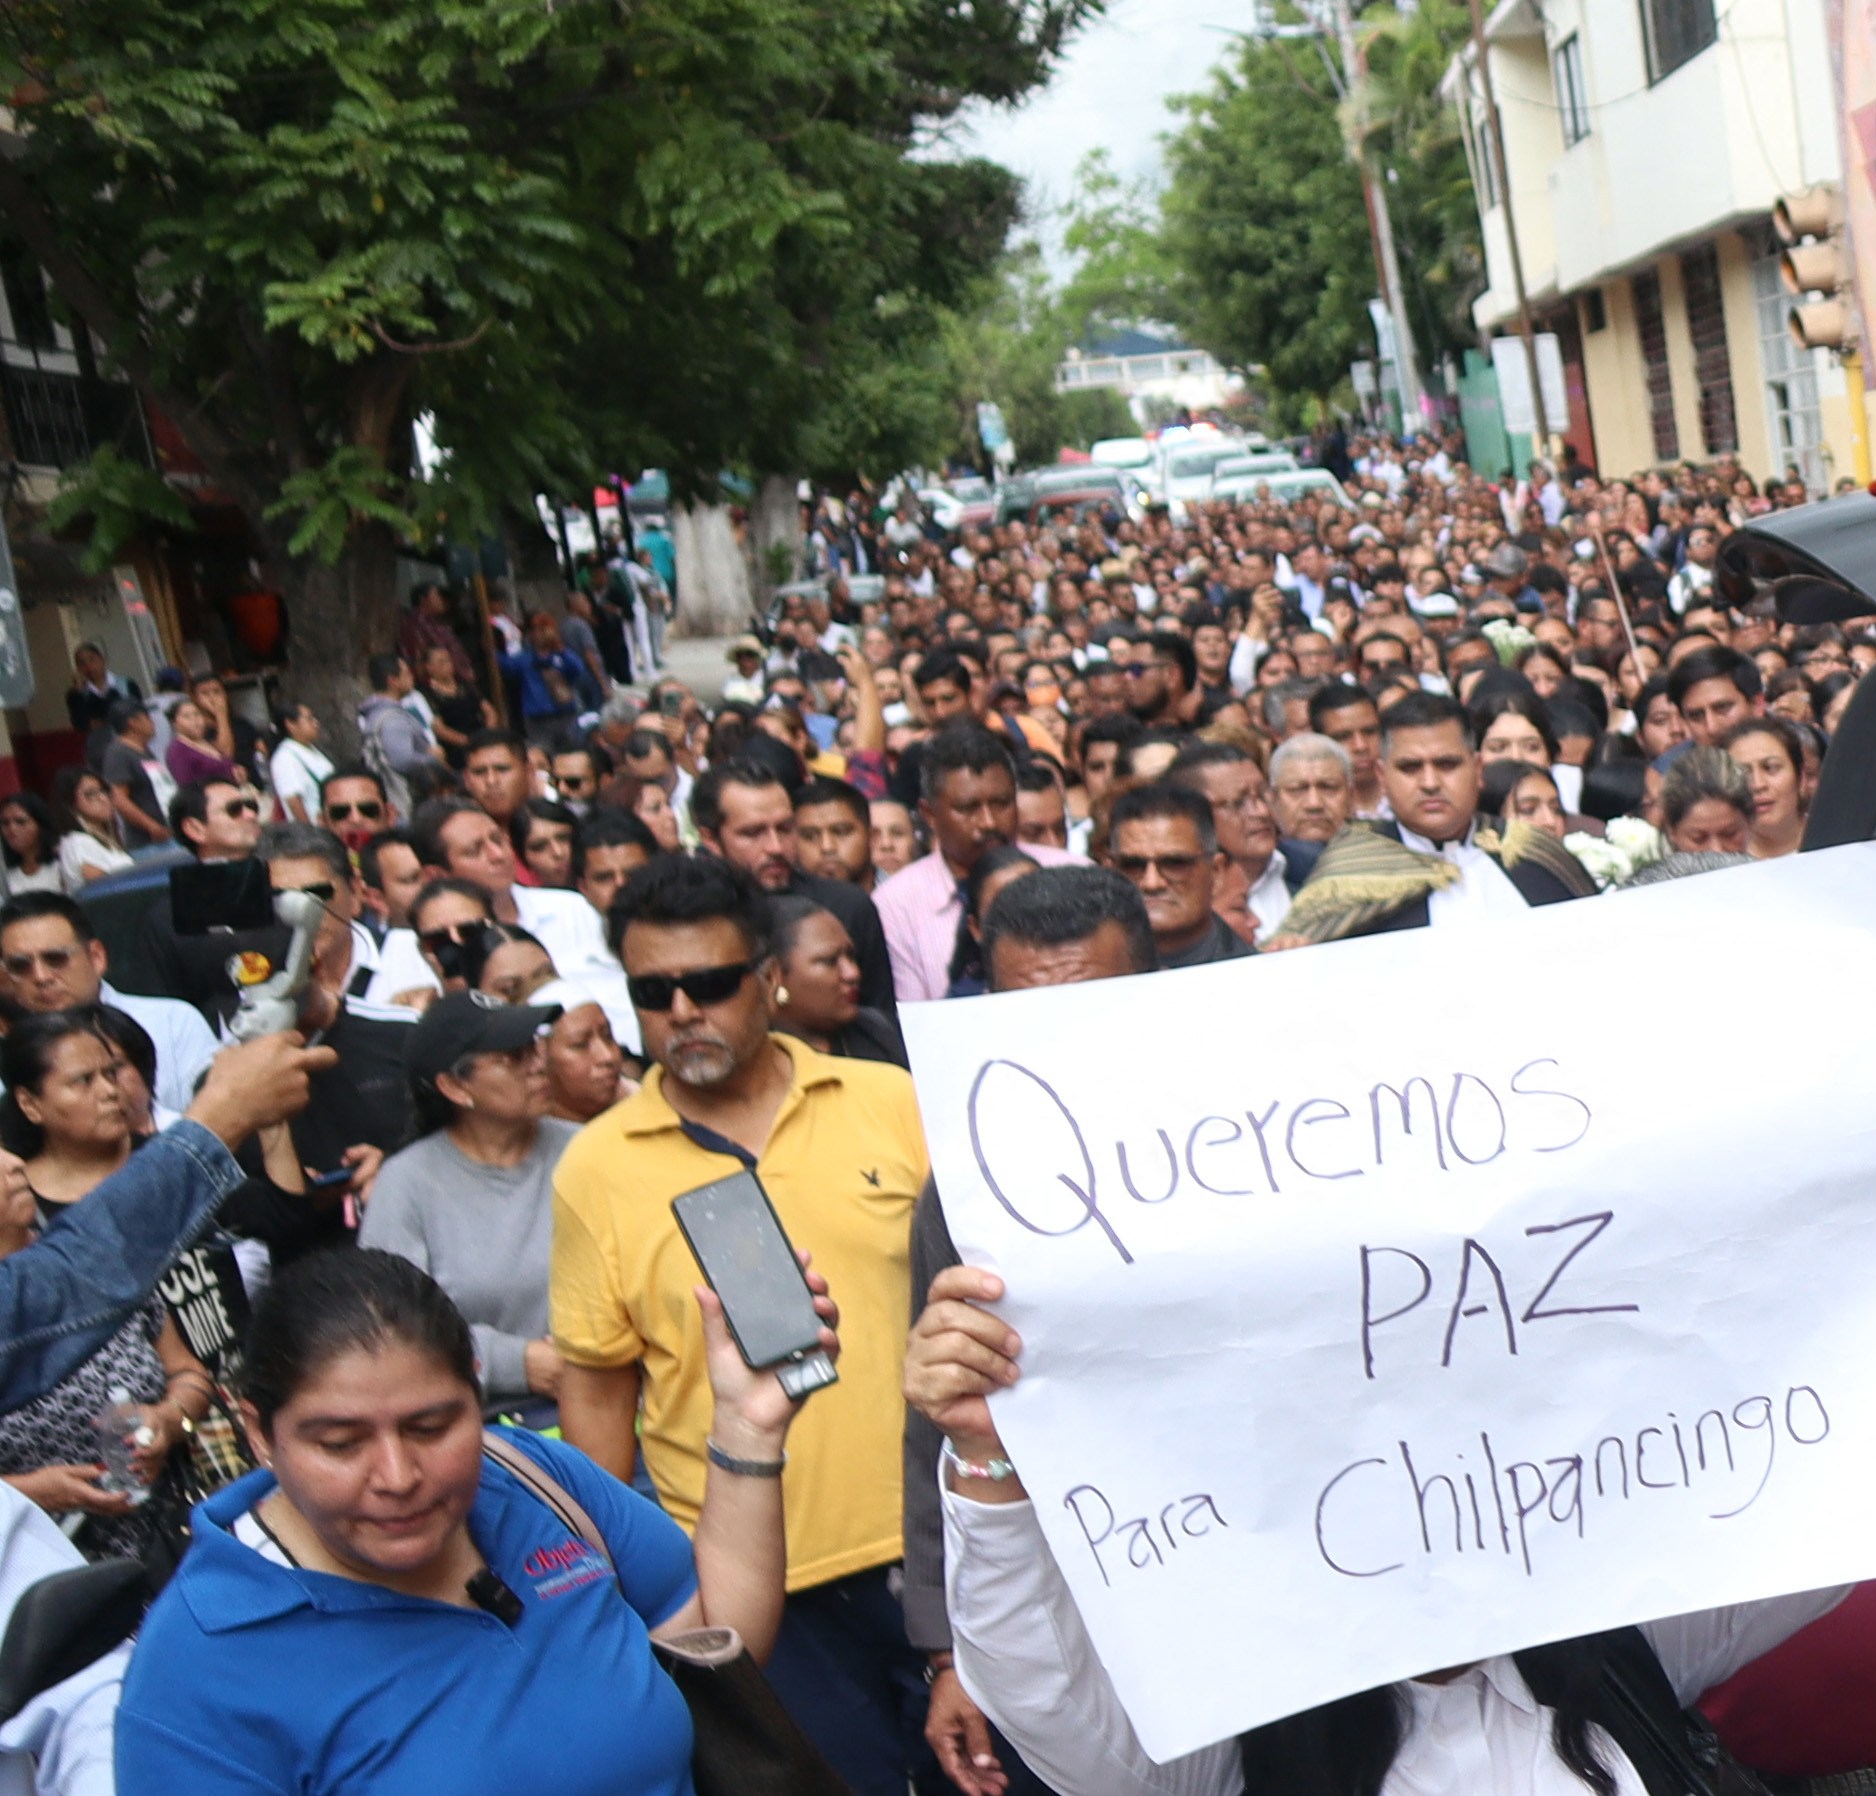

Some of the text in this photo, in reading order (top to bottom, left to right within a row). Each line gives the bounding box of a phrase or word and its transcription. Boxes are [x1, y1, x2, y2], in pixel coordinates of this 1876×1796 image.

[967, 1057, 1592, 1264] Queremos
[175, 1287, 236, 1359] MINE
[1359, 1210, 1640, 1379] PAZ
[1063, 1384, 1831, 1587] Para Chilpancingo
